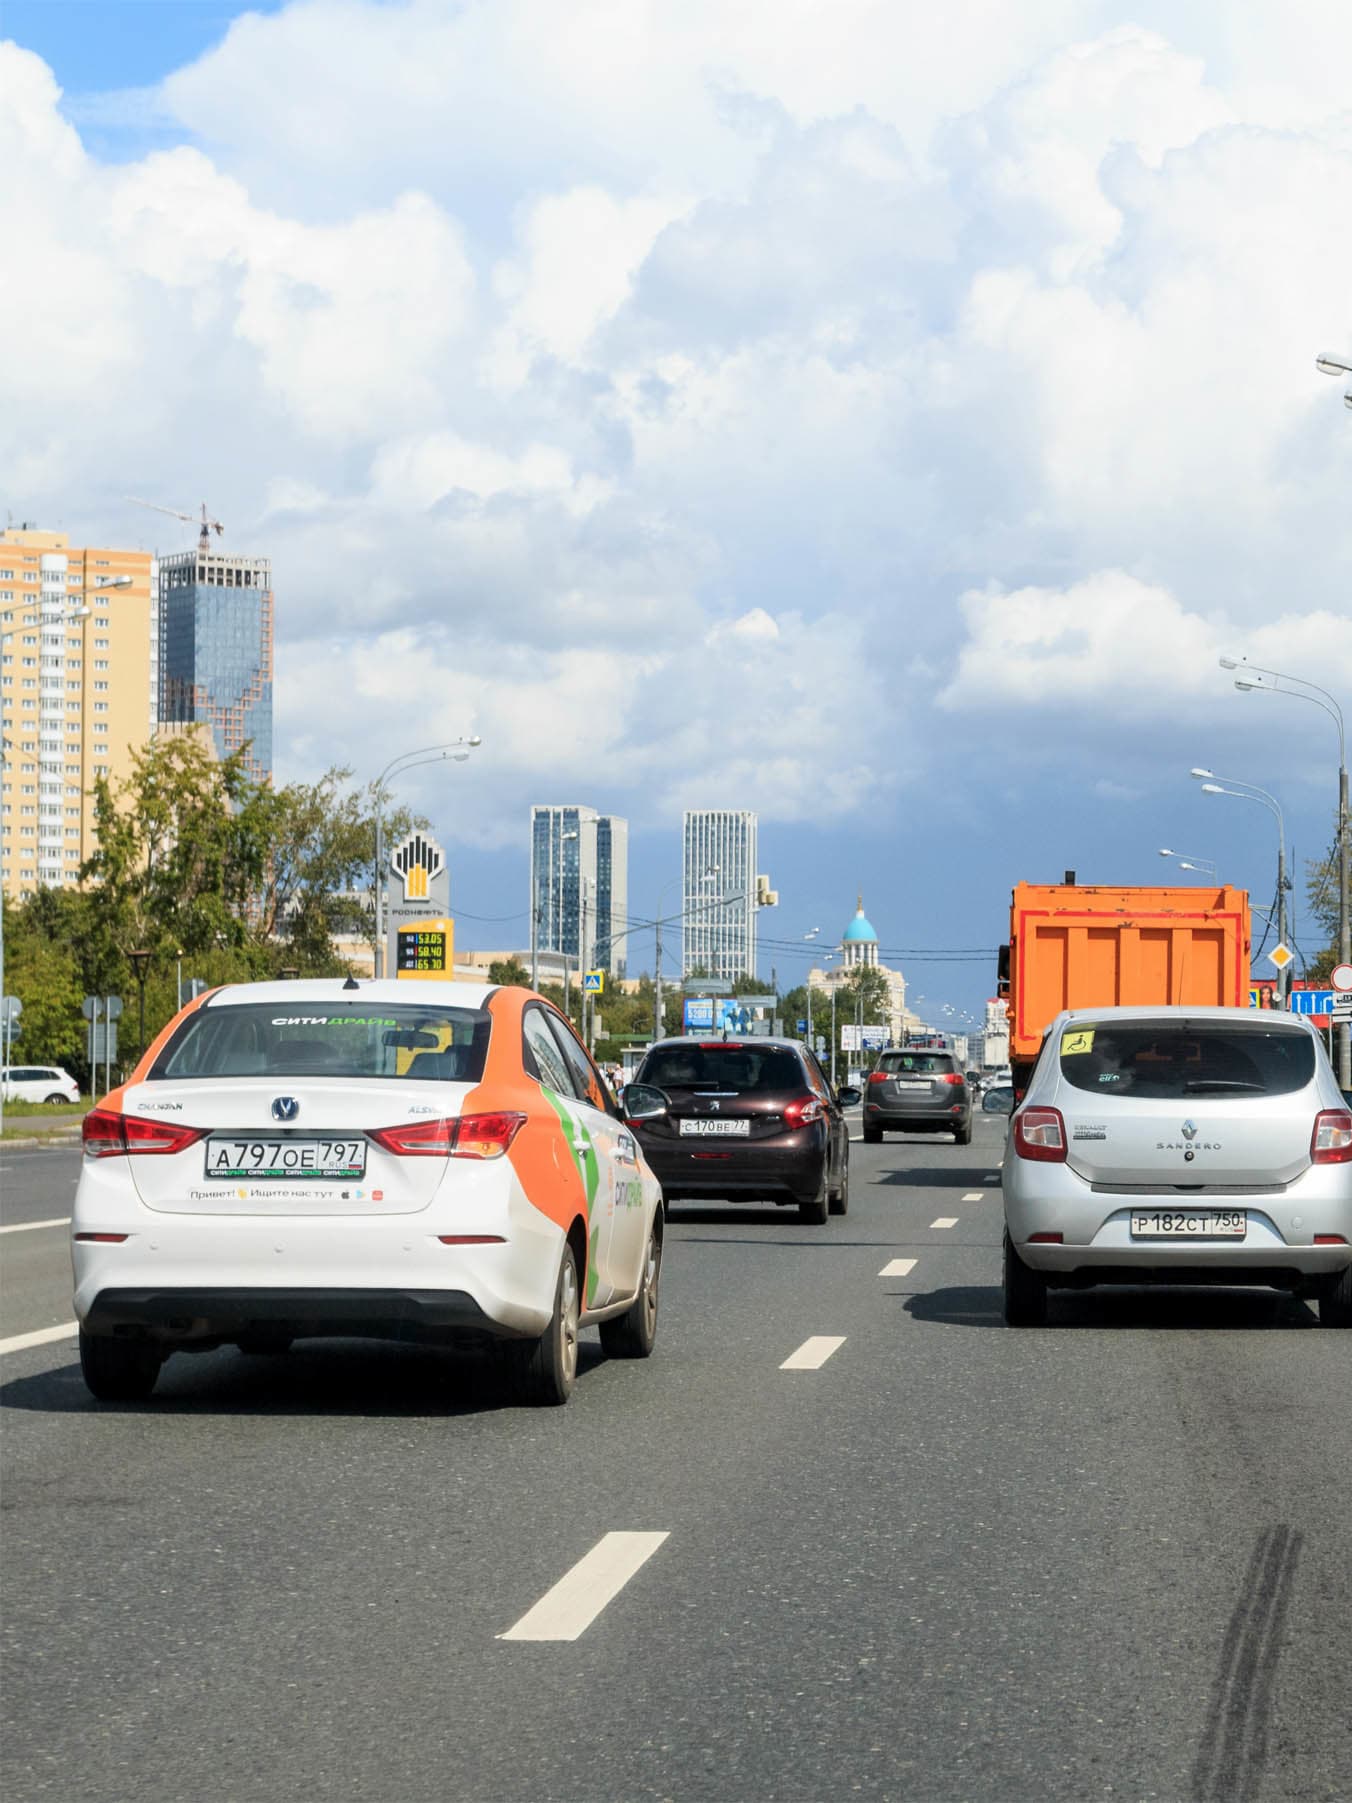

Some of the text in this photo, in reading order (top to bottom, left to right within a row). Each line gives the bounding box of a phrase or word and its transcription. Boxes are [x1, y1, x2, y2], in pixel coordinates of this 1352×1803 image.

[418, 947, 442, 957] 58.40
[271, 1017, 397, 1026] СИТИДРАЙВ
[216, 1143, 359, 1168] А797ОЕ 797
[190, 1189, 235, 1199] Привет!
[1138, 1213, 1240, 1232] Р182СТ 750
